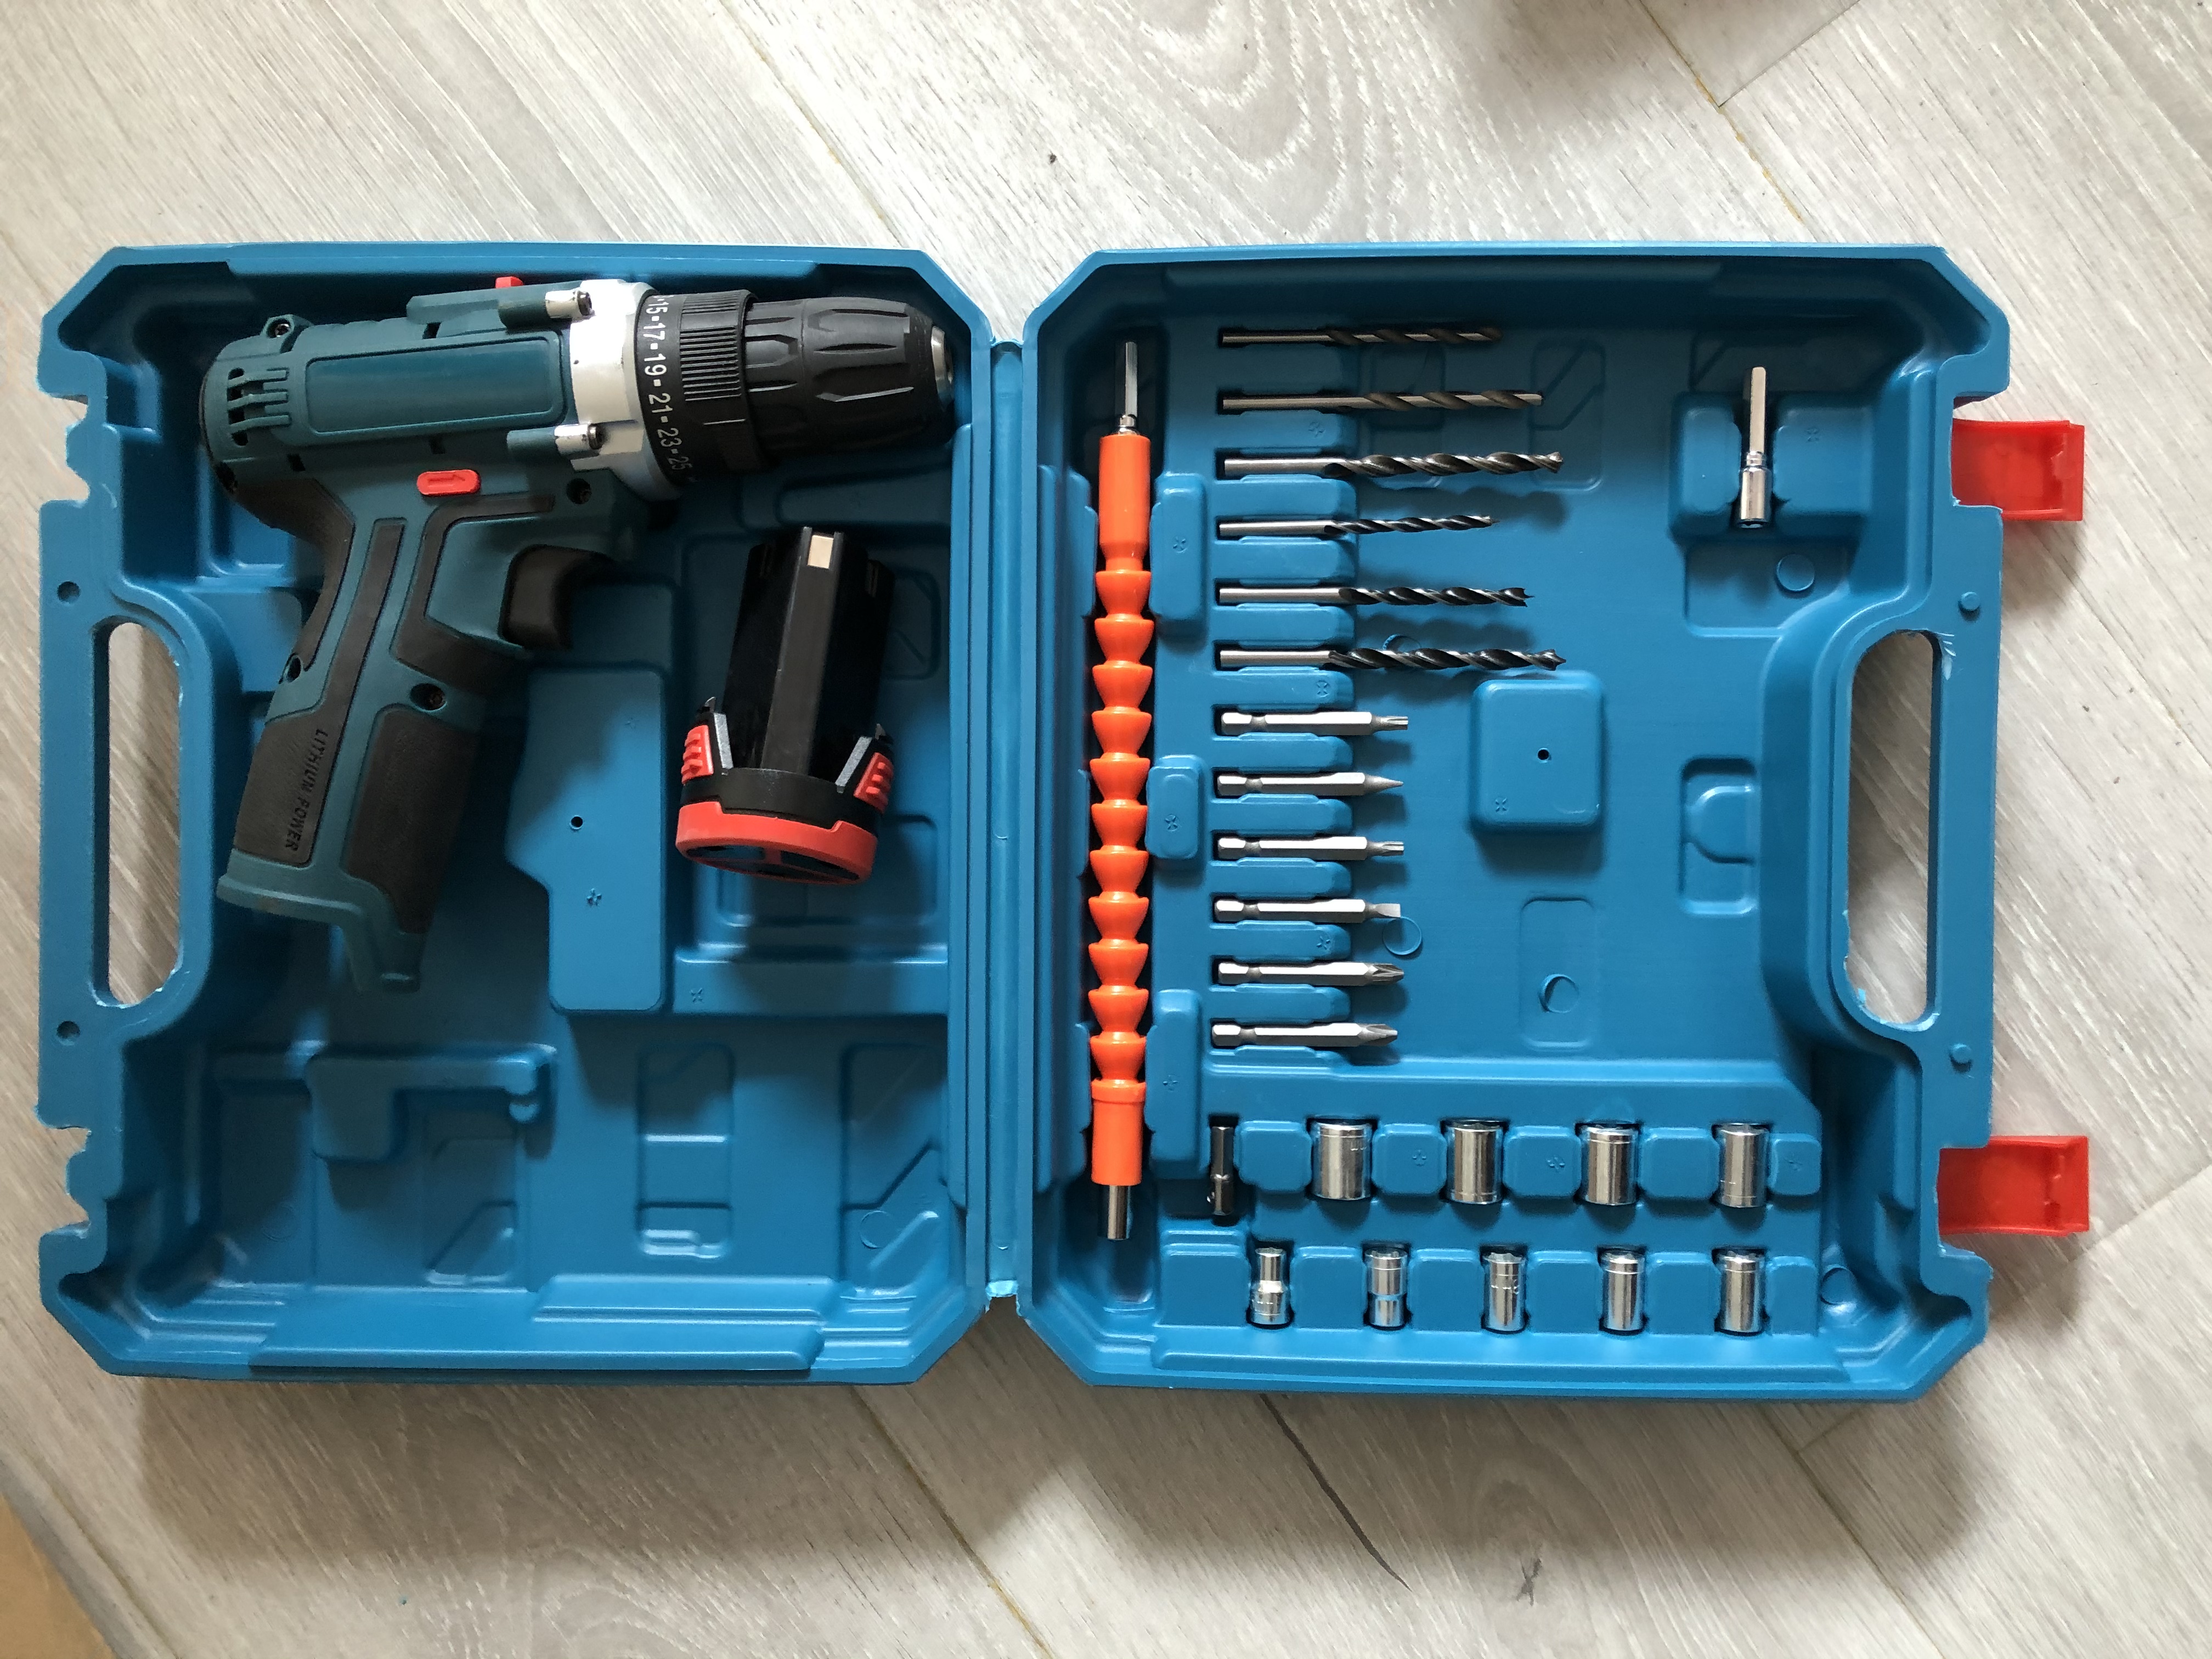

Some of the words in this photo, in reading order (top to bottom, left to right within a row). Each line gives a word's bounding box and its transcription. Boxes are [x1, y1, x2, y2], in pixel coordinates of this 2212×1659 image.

[646, 301, 669, 314] 15
[643, 323, 666, 340] 17
[644, 353, 667, 376] 19
[648, 393, 673, 413] 21
[657, 427, 682, 447] 23
[285, 796, 310, 851] POWER
